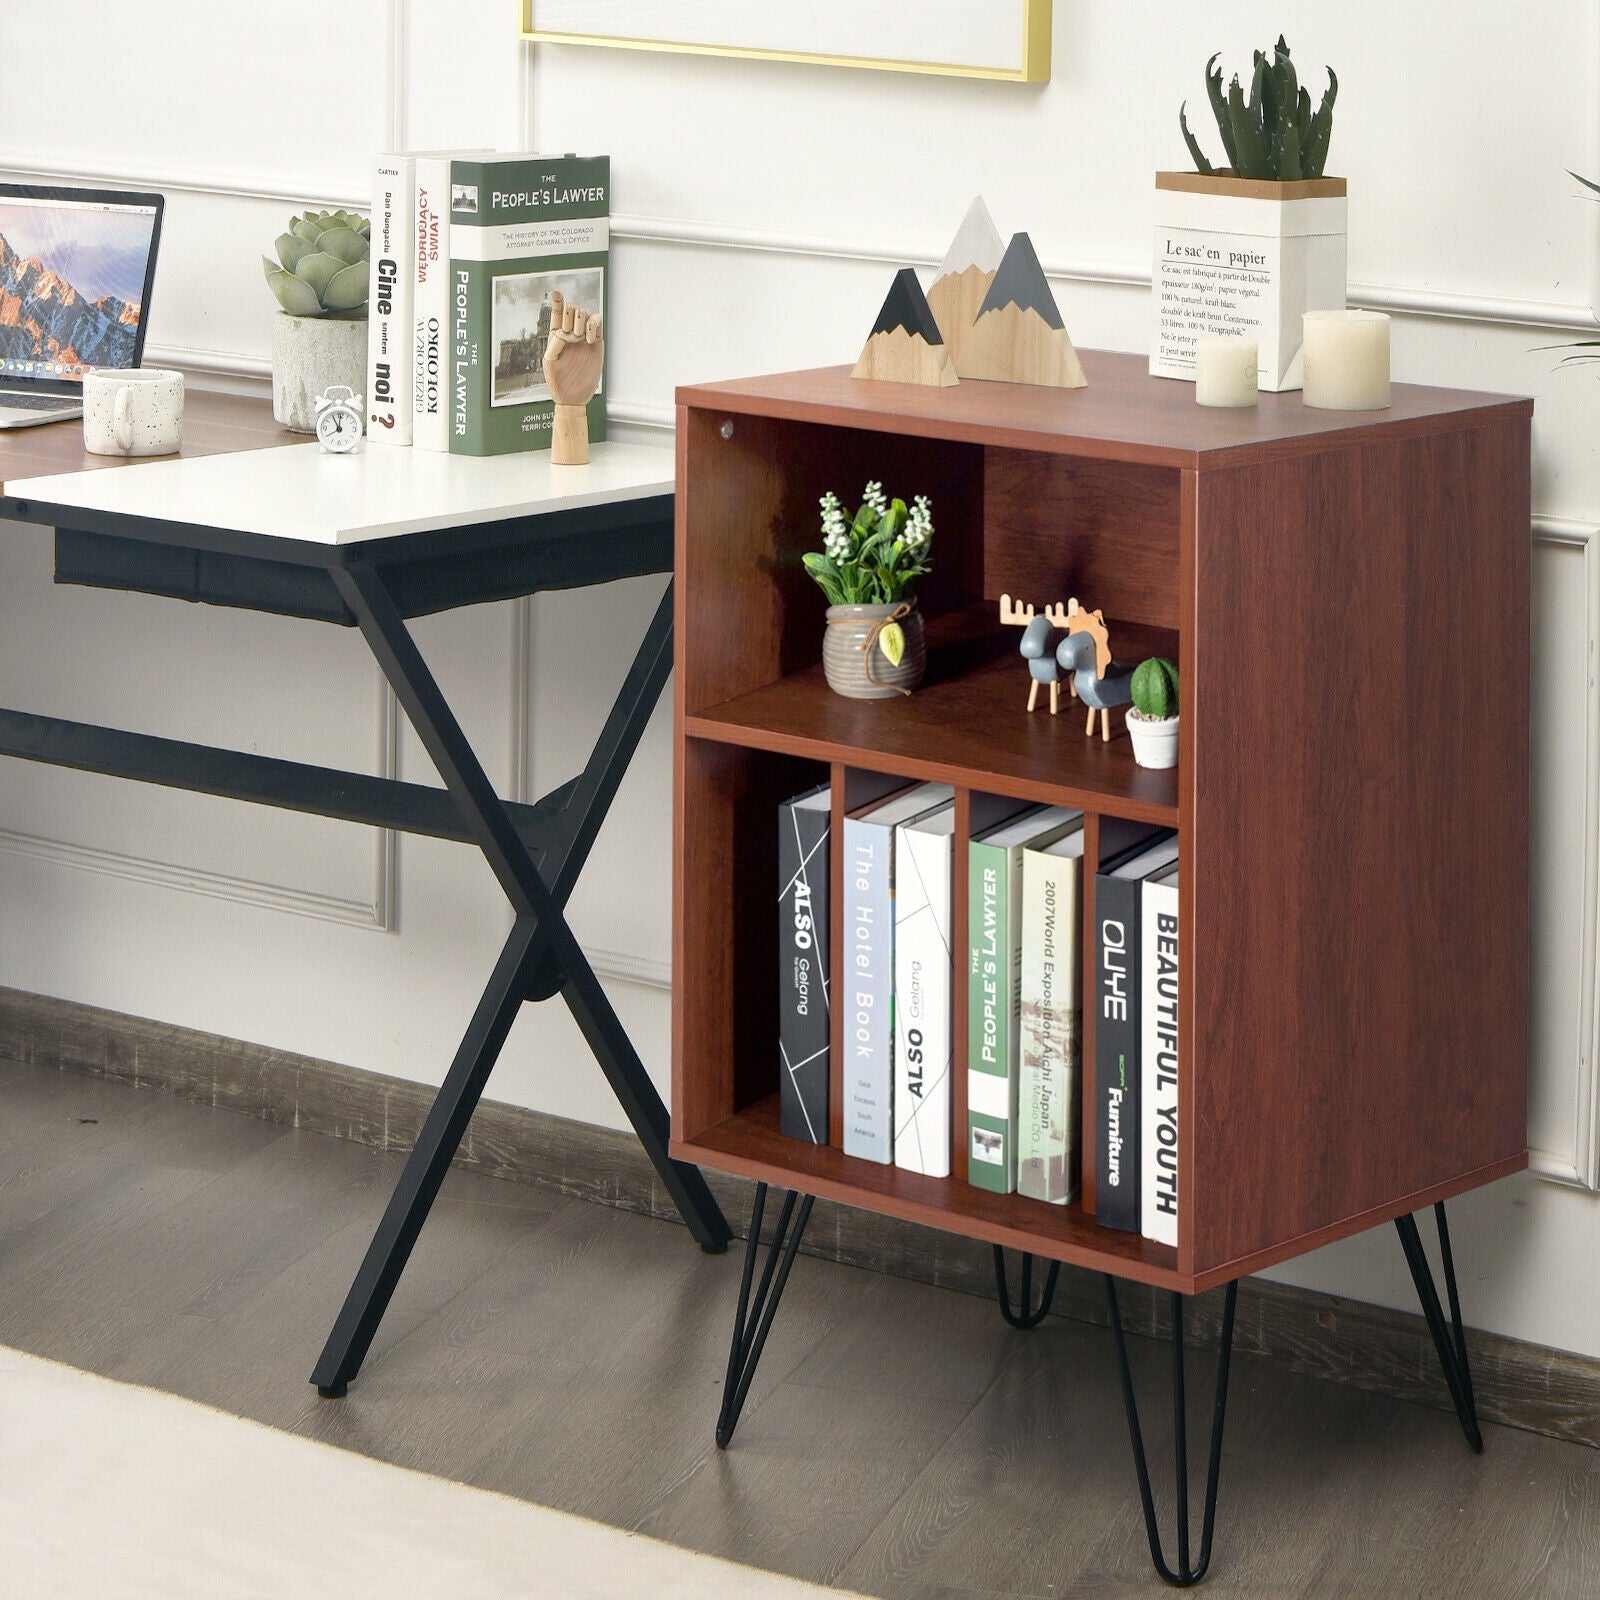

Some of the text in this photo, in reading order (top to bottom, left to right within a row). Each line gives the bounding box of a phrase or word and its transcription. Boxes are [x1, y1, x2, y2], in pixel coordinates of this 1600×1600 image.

[377, 168, 399, 176] CARTIER
[541, 174, 556, 183] THE
[384, 192, 392, 209] Dan
[492, 187, 604, 208] PEOPLE'S LAWYER
[1161, 264, 1171, 273] Ce
[1183, 267, 1191, 275] est
[1222, 272, 1239, 281] partir
[1166, 239, 1182, 255] Le
[1207, 249, 1220, 260] en
[1229, 250, 1266, 267] papier
[377, 258, 397, 315] Cine
[1161, 292, 1172, 301] 100
[455, 270, 469, 436] PEOPLE'S LAWYER
[374, 362, 394, 404] noi
[521, 423, 541, 432] TERRI
[522, 411, 555, 423] JOHN SUT
[794, 879, 812, 1016] ALSO Gelang
[855, 843, 874, 1059] The Hotel Book
[971, 947, 980, 975] THE
[981, 867, 998, 1064] PEOPLE'S LAWYER
[909, 960, 922, 1019] Gelang
[1041, 961, 1055, 1039] Exposition
[907, 1028, 923, 1099] ALSO
[1041, 1043, 1053, 1081] Aichi
[1156, 912, 1179, 1216] BEAUTIFUL YOUTH
[1038, 1084, 1052, 1129] Japan
[1108, 1087, 1124, 1187] Furniture
